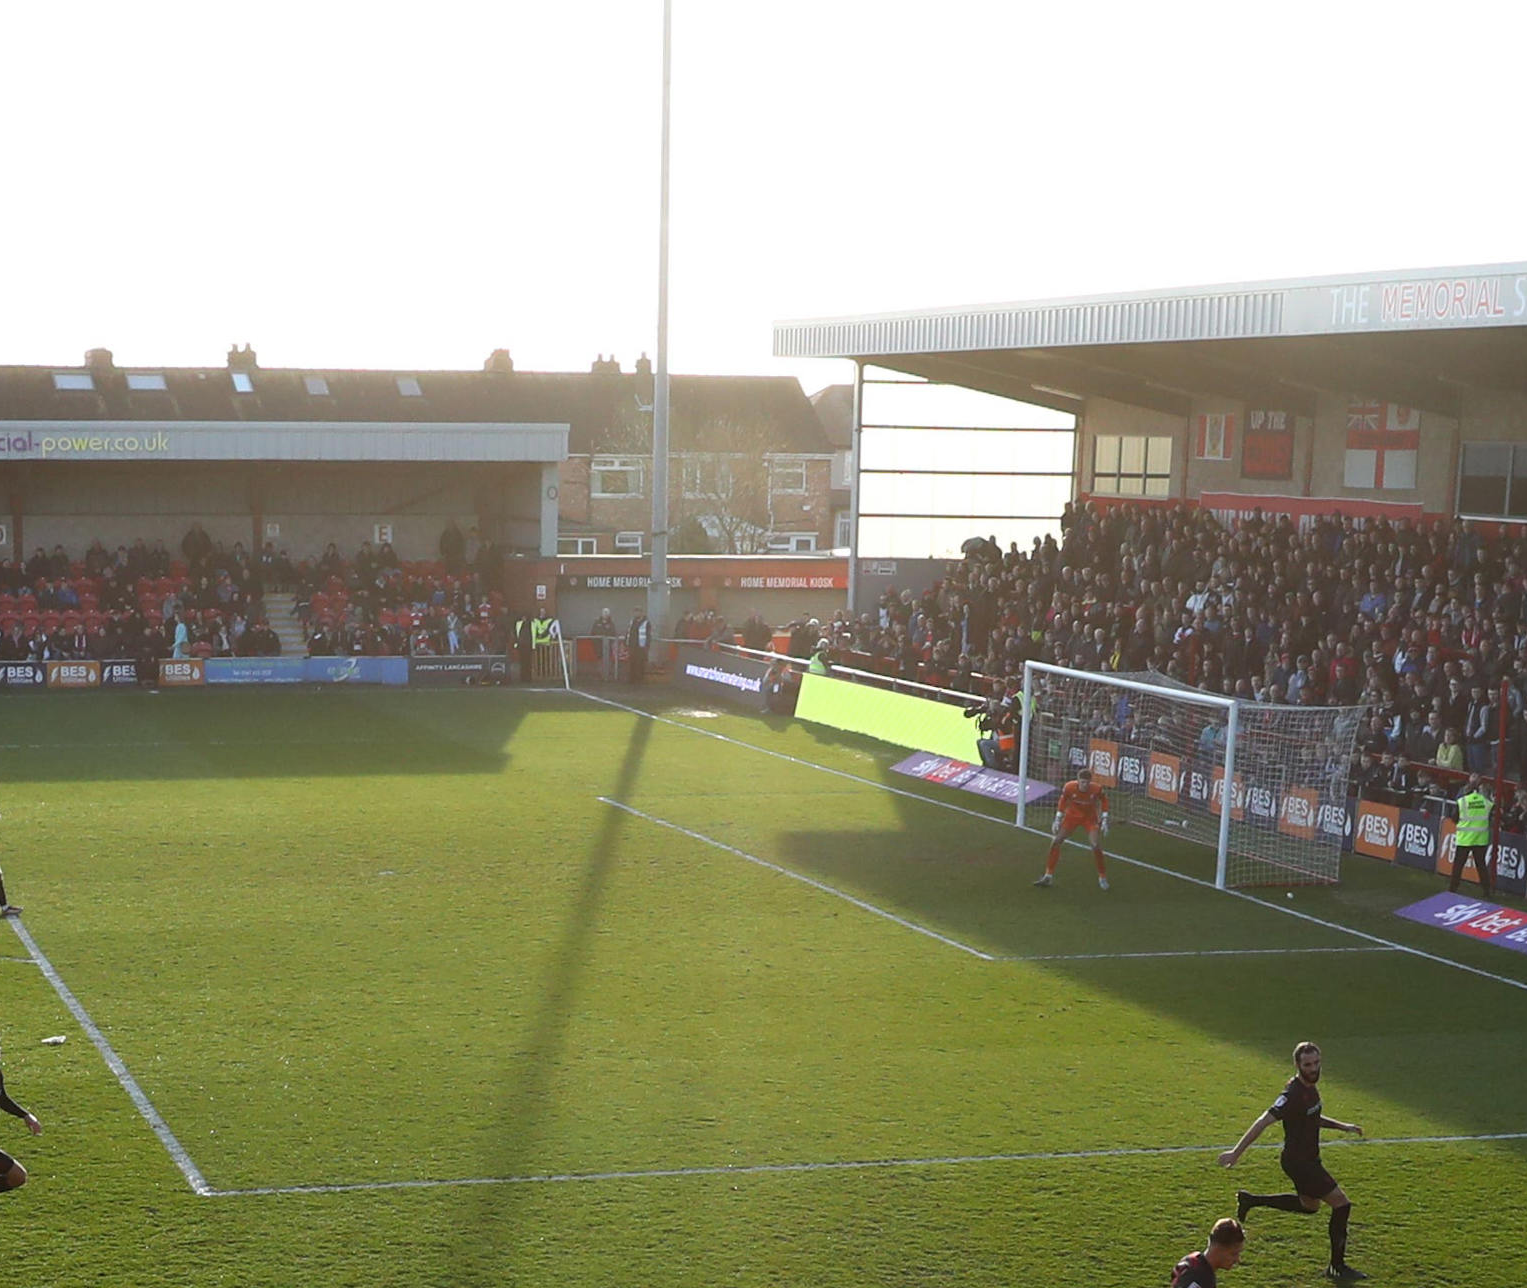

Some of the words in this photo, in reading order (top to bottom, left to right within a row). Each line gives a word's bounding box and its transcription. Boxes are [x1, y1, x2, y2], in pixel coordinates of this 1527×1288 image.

[1330, 286, 1370, 325] THE
[1382, 279, 1504, 322] MEMORIAL
[1250, 410, 1265, 430] UP
[1268, 411, 1286, 430] THE
[378, 526, 389, 542] E
[587, 577, 611, 588] HOME
[613, 577, 650, 588] MEMORIA
[740, 577, 765, 588] HOME
[766, 577, 808, 588] MEMORIAL
[809, 577, 834, 588] KIOSK
[7, 666, 34, 677] BES
[60, 665, 87, 677] BES
[165, 664, 191, 675] BES
[1094, 750, 1111, 767] BES
[1122, 756, 1140, 774] BES
[932, 760, 963, 778] bet
[1154, 764, 1172, 782] BES
[1251, 787, 1271, 807] BES
[1288, 796, 1309, 817] BES
[1325, 804, 1346, 826] BES
[1365, 814, 1389, 836] BES
[1405, 823, 1429, 845] BES
[1434, 902, 1482, 926] sky
[1469, 908, 1523, 935] bet
